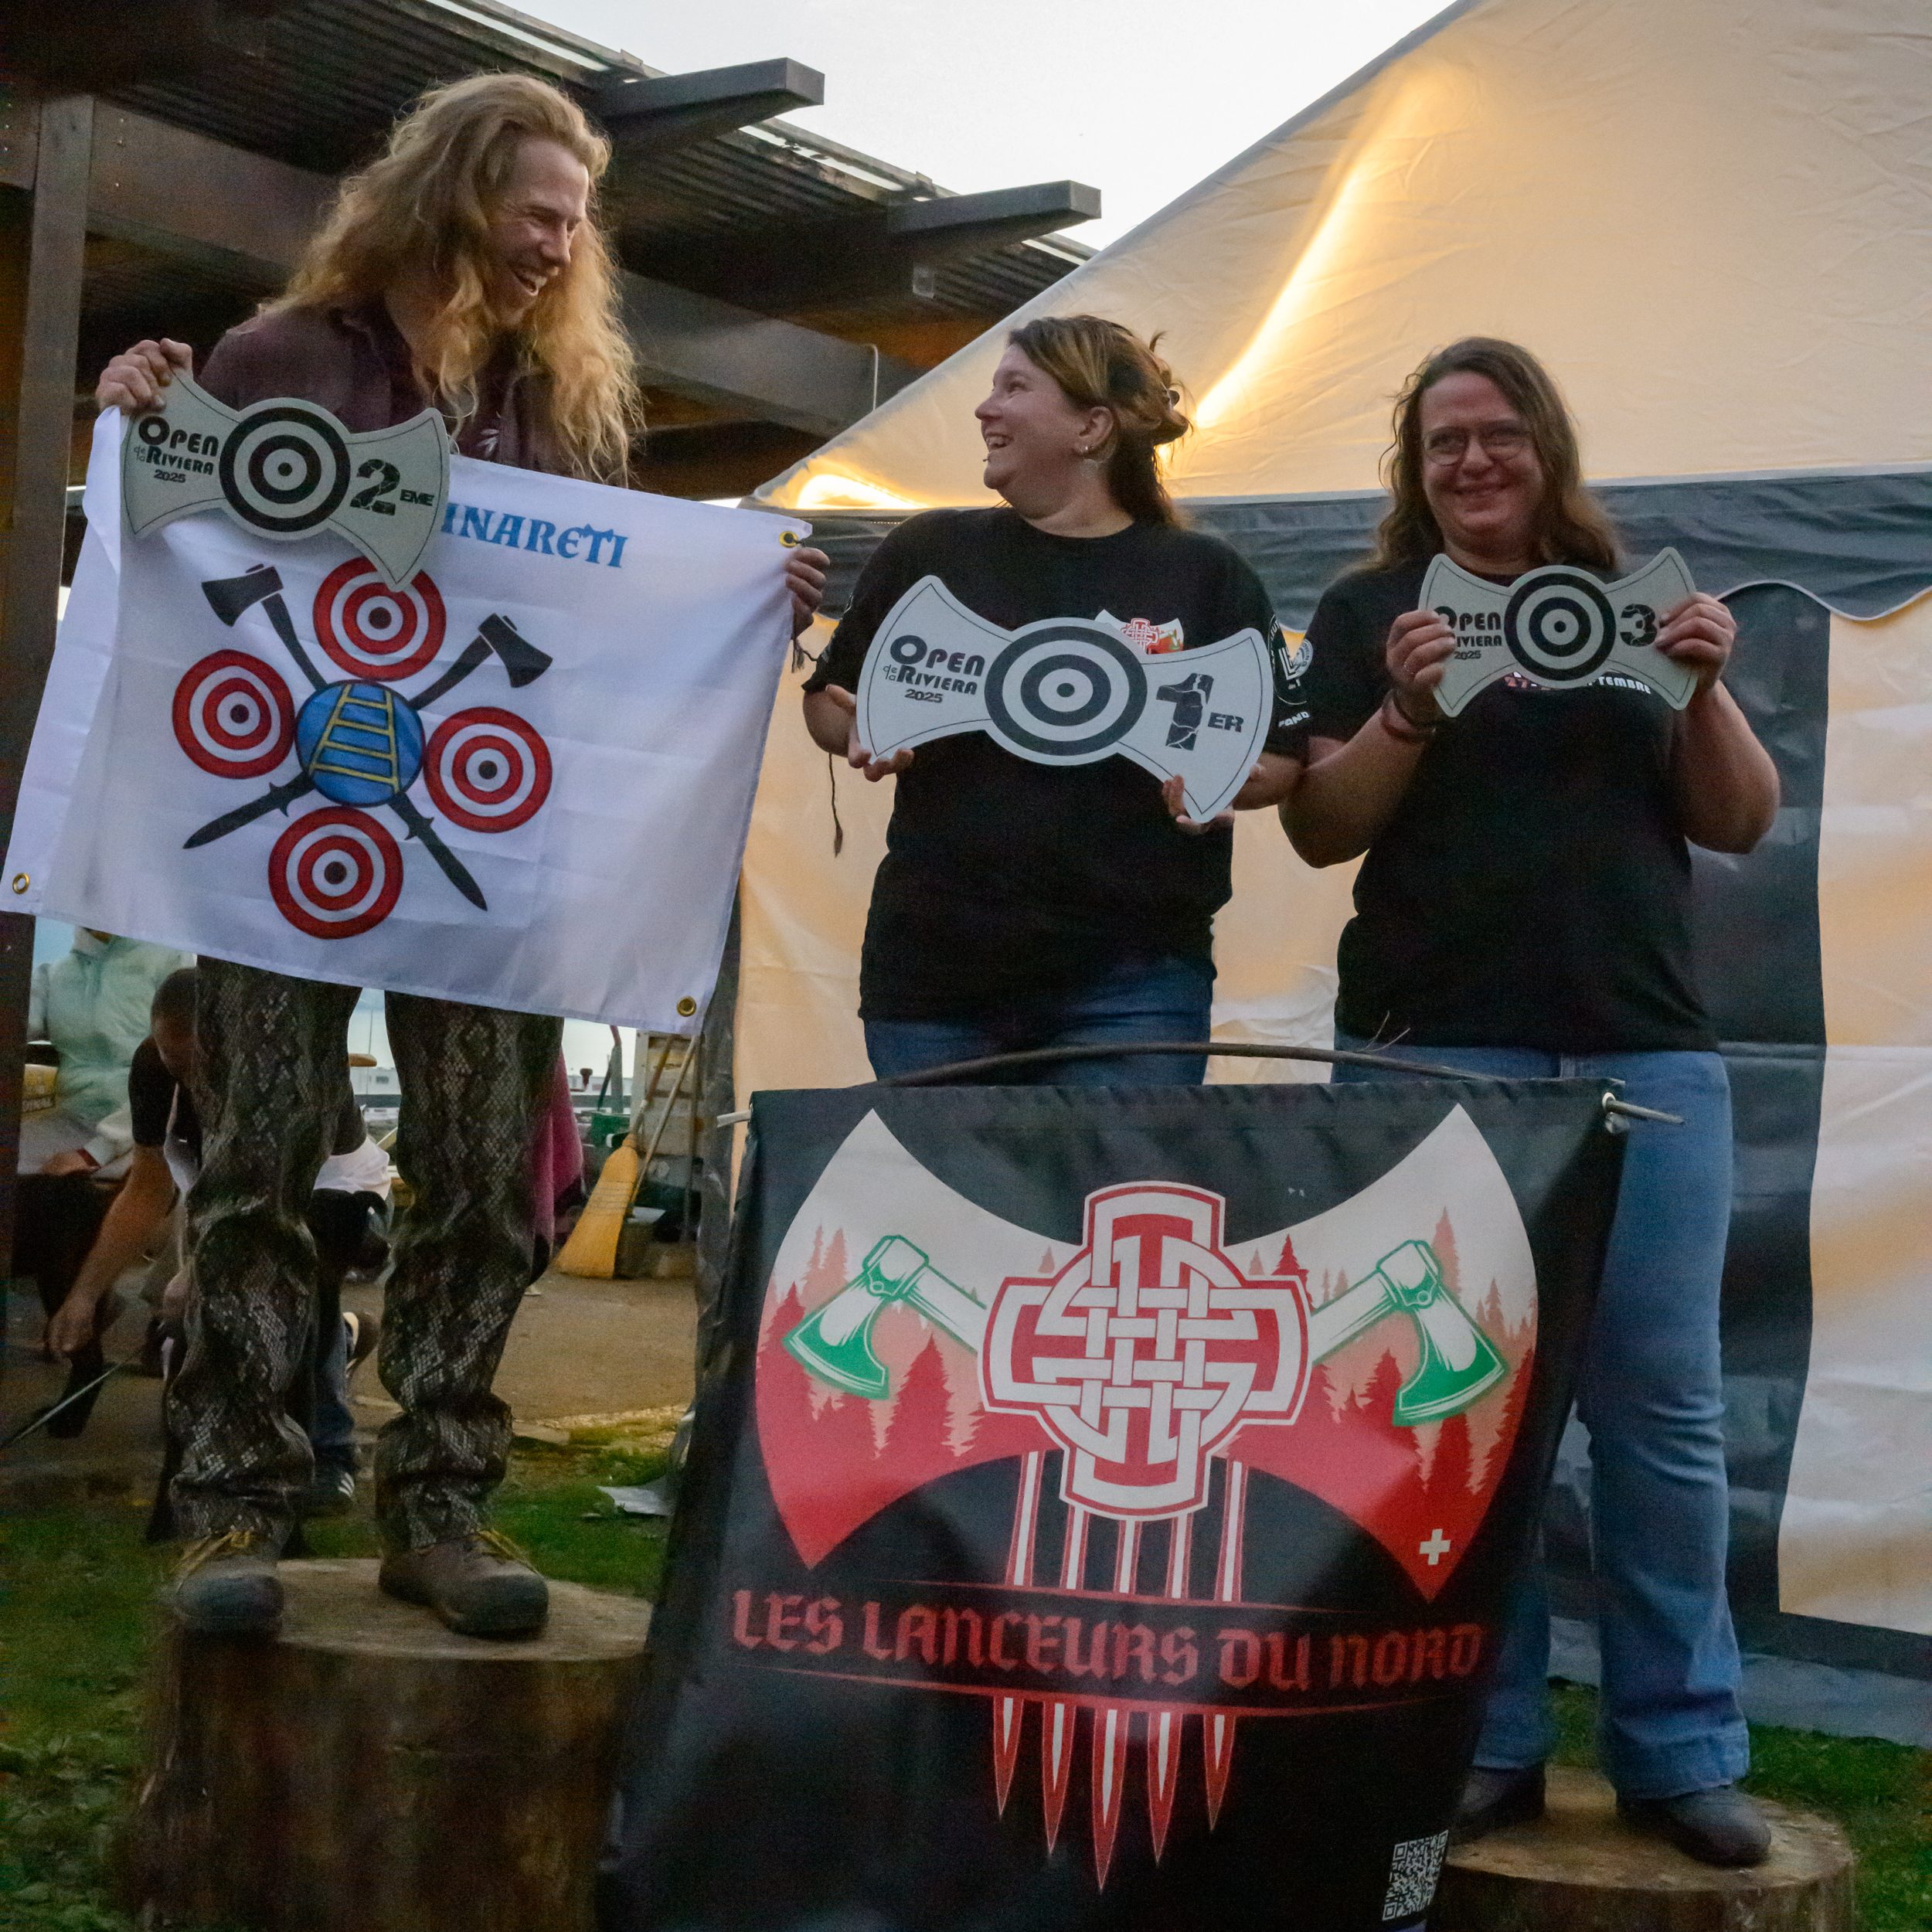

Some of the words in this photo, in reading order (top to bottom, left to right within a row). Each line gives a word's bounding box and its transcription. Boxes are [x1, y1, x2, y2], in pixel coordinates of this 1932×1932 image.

[138, 416, 219, 457] OPEN
[146, 445, 214, 476] RIVIERA
[154, 468, 186, 483] 2025
[890, 635, 985, 677] OPEN
[1452, 633, 1502, 648] IVIERA
[1454, 650, 1482, 661] 2025
[883, 665, 897, 675] de
[896, 665, 978, 696] RIVIERA
[905, 689, 944, 703] 2025
[733, 1589, 844, 1655] LES
[862, 1601, 1198, 1686] LANCEURS
[1216, 1628, 1311, 1692] DU
[1329, 1622, 1482, 1690] NORD
